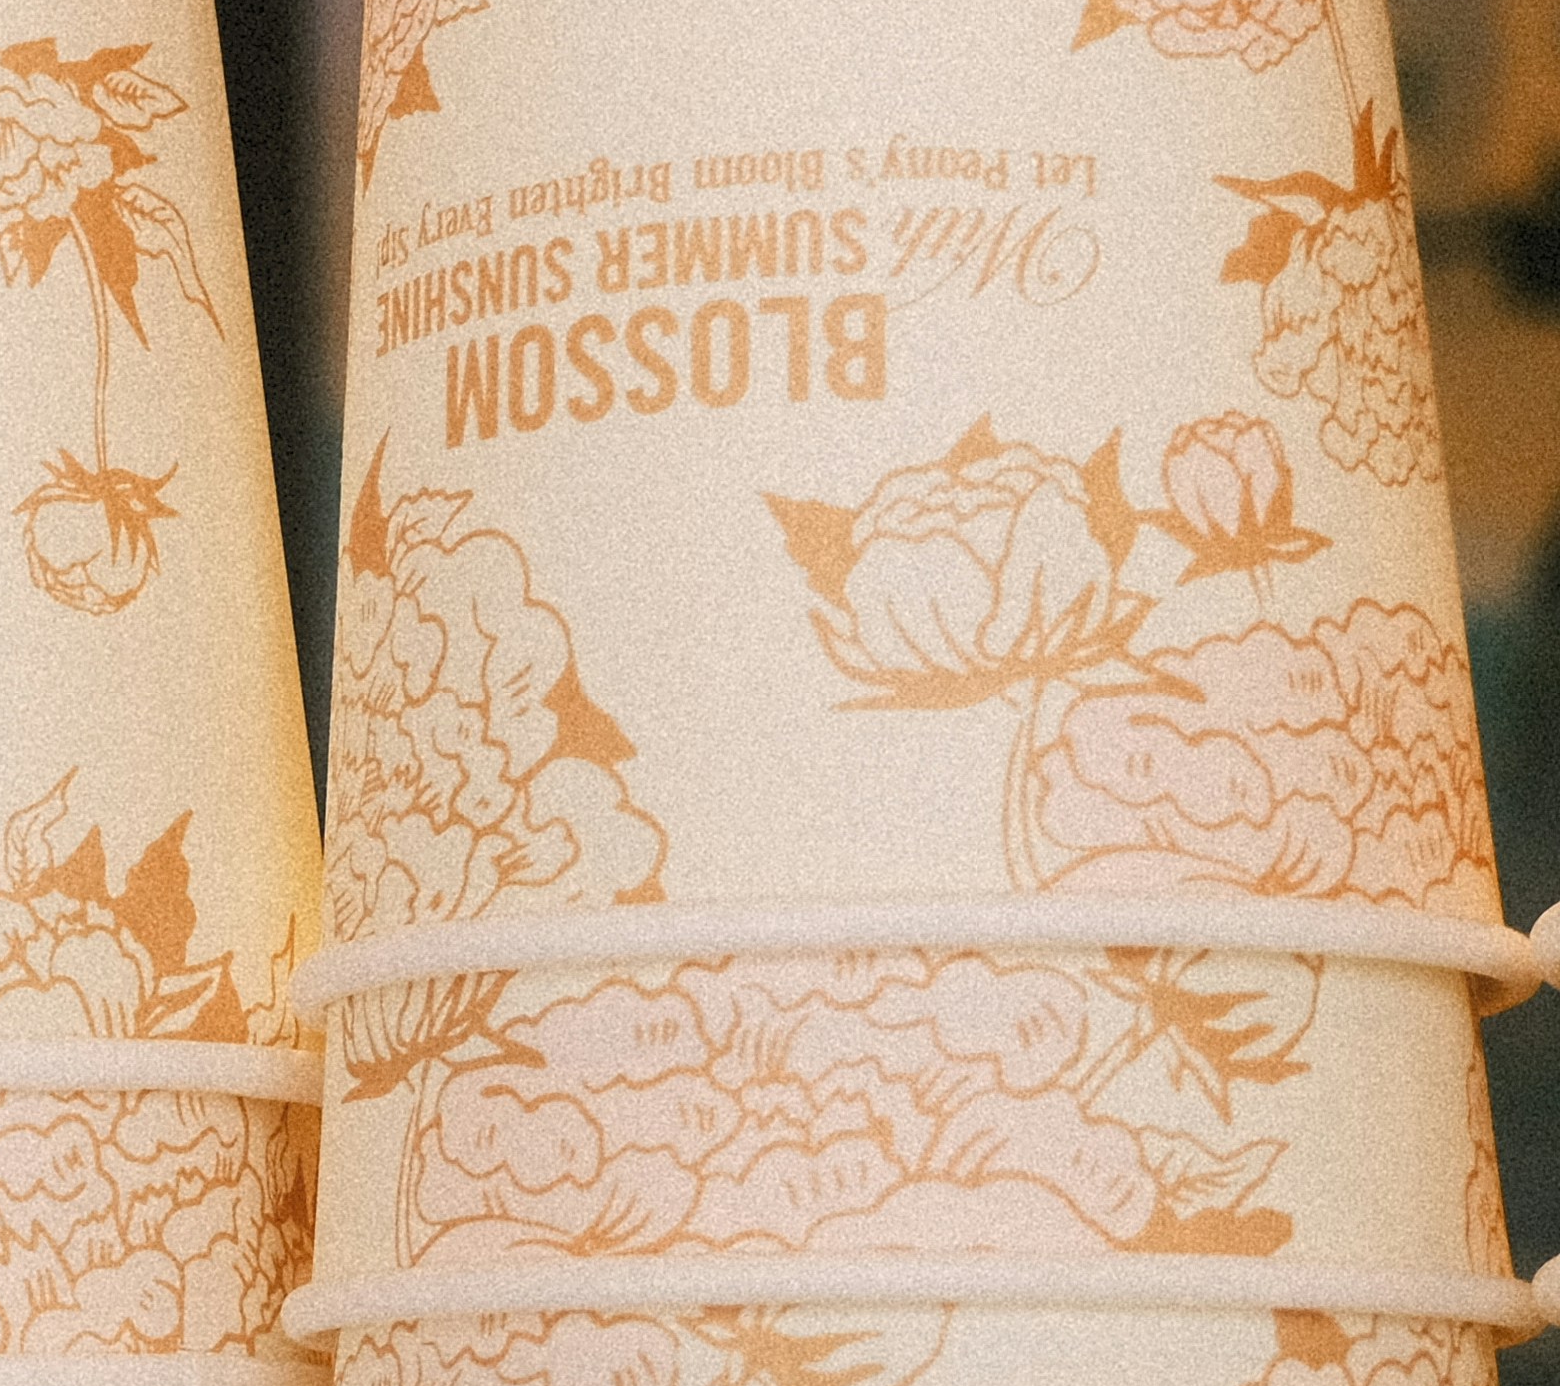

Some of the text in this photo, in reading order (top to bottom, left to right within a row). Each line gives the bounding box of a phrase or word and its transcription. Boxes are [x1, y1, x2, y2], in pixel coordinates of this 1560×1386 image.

[509, 157, 671, 217] Brighten
[694, 149, 823, 191] Bloom
[847, 134, 1011, 193] Peony's
[1034, 150, 1097, 196] Let
[418, 194, 494, 249] Every
[375, 207, 1100, 358] With SUMMER SUNSHINE
[445, 293, 888, 449] BLOSSOM
